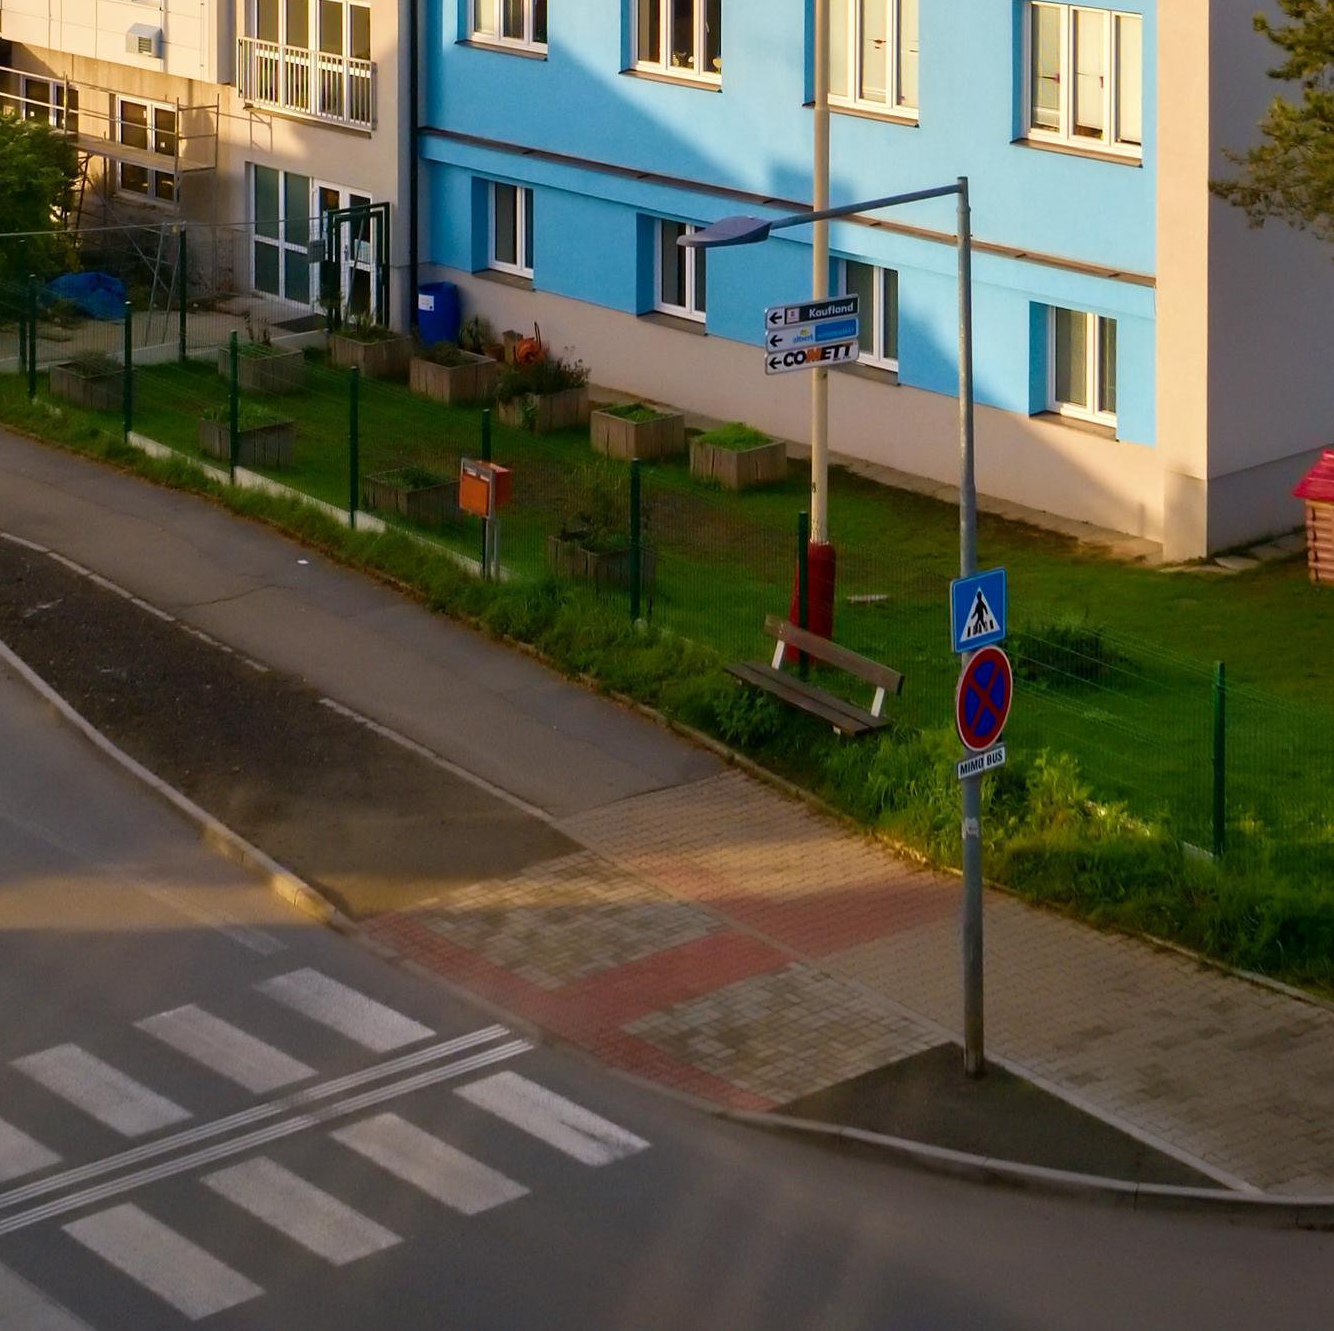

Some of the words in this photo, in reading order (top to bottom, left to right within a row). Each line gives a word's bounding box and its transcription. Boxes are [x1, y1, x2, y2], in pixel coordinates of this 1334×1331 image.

[809, 302, 854, 319] Kaufland
[783, 342, 854, 367] COMETT
[960, 757, 984, 775] MIMO
[987, 750, 1003, 766] BUS
